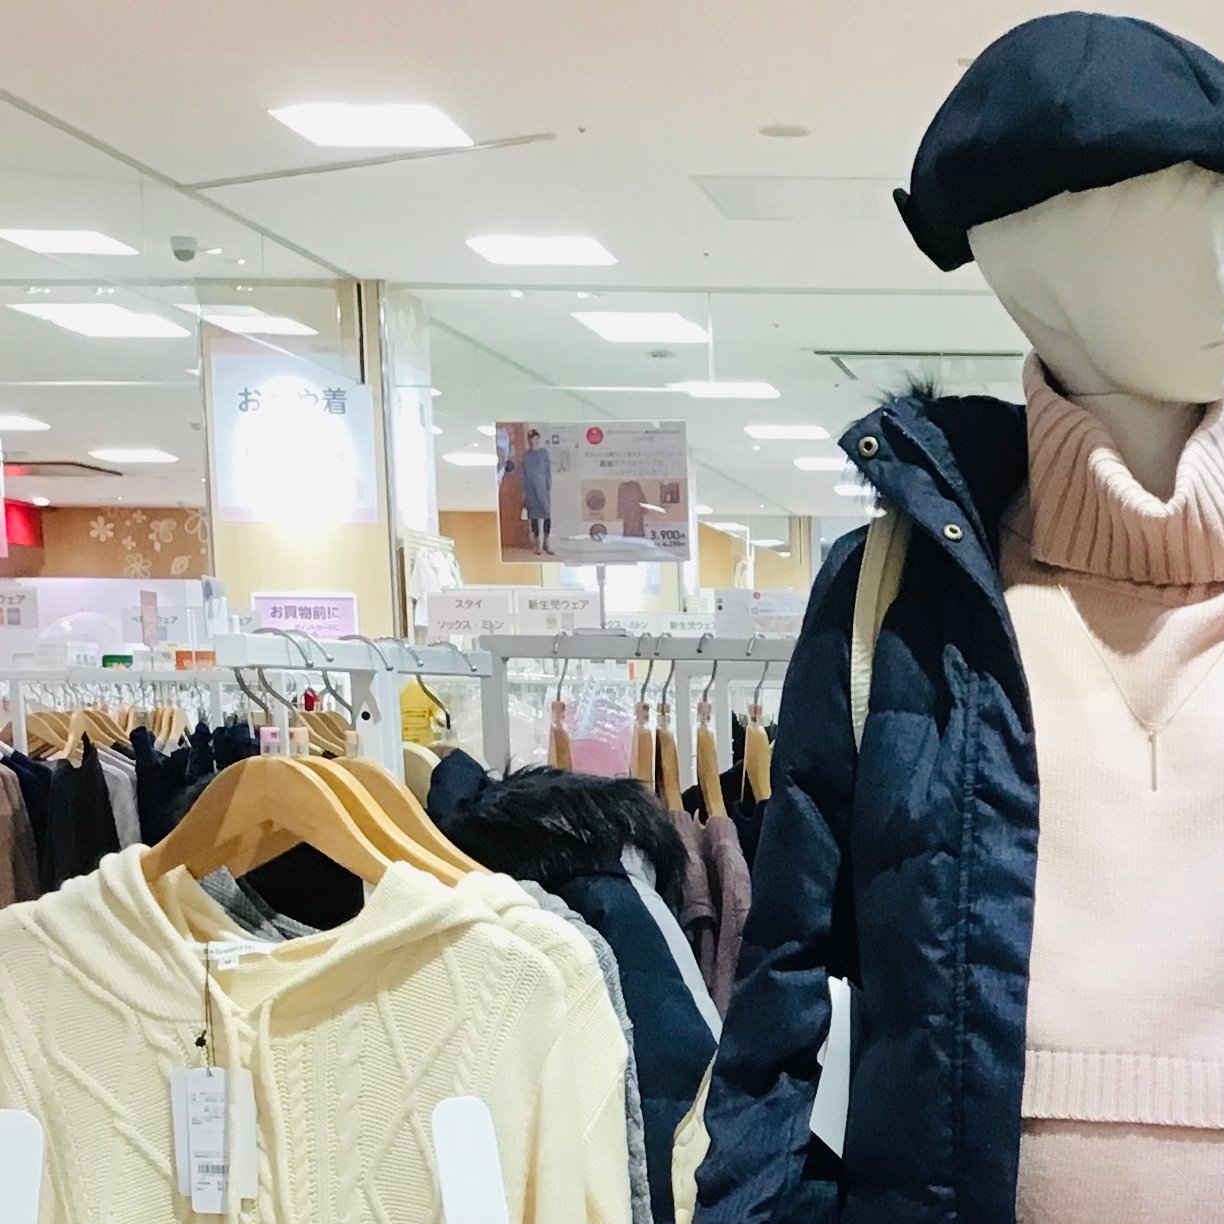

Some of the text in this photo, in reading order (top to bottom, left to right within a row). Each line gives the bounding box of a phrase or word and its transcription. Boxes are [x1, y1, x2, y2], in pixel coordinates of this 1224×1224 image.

[455, 599, 483, 609] スタイ
[270, 604, 340, 620] お買物前に
